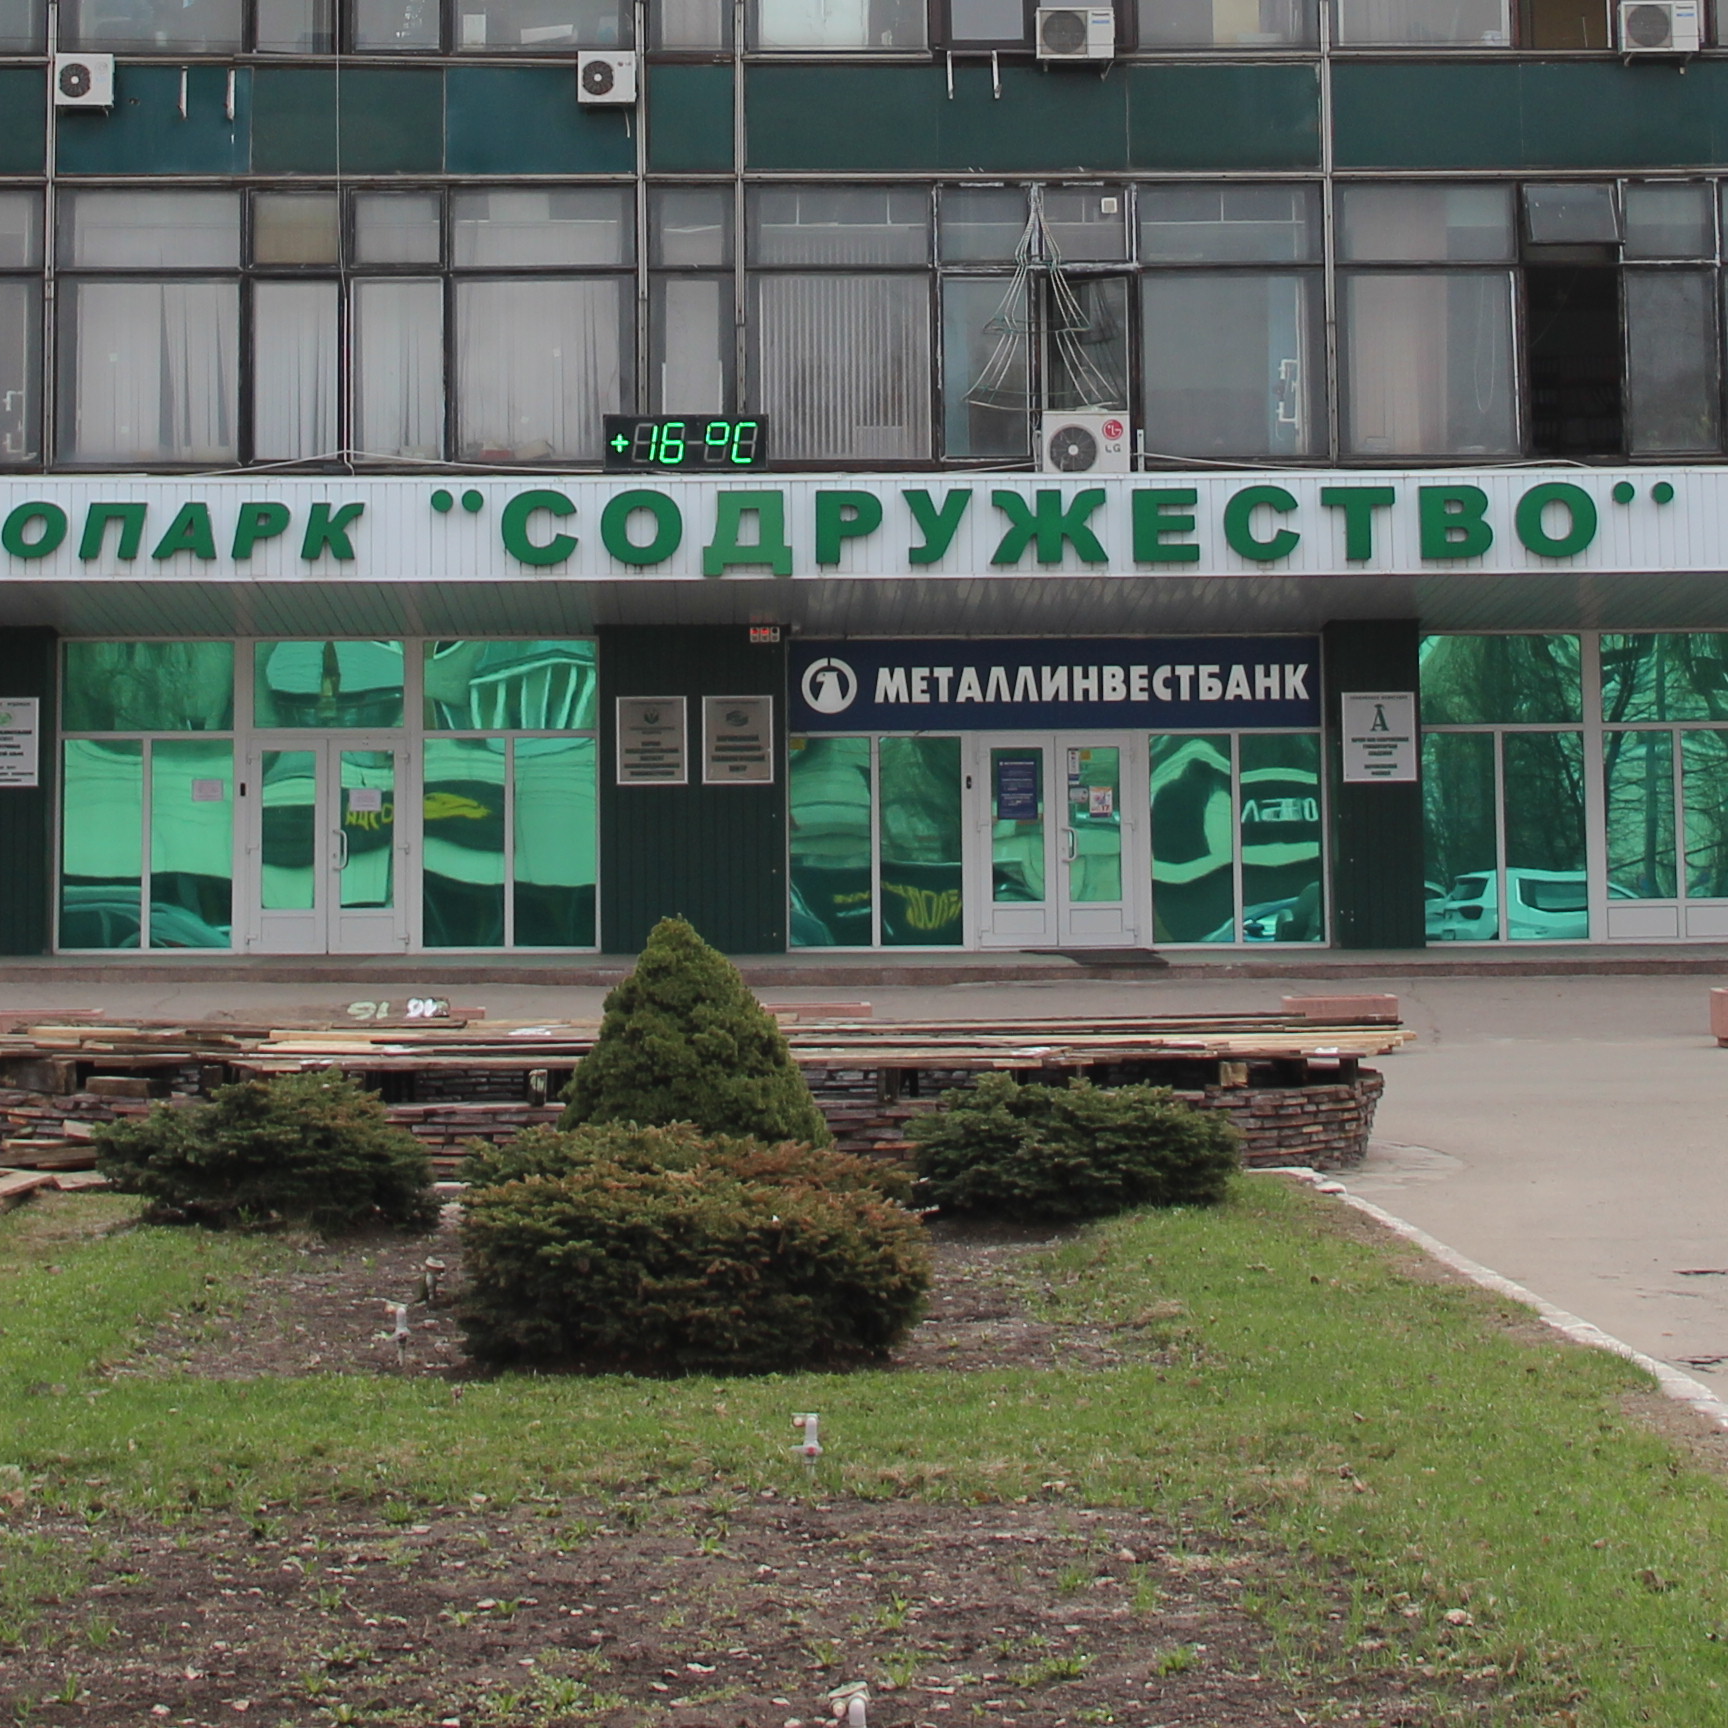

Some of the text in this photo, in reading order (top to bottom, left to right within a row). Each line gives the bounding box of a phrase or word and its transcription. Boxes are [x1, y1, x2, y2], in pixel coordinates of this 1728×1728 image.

[610, 421, 684, 464] +16
[1105, 443, 1121, 453] LG
[874, 663, 1310, 704] МЕТАЛЛИНВЕСТБАНК
